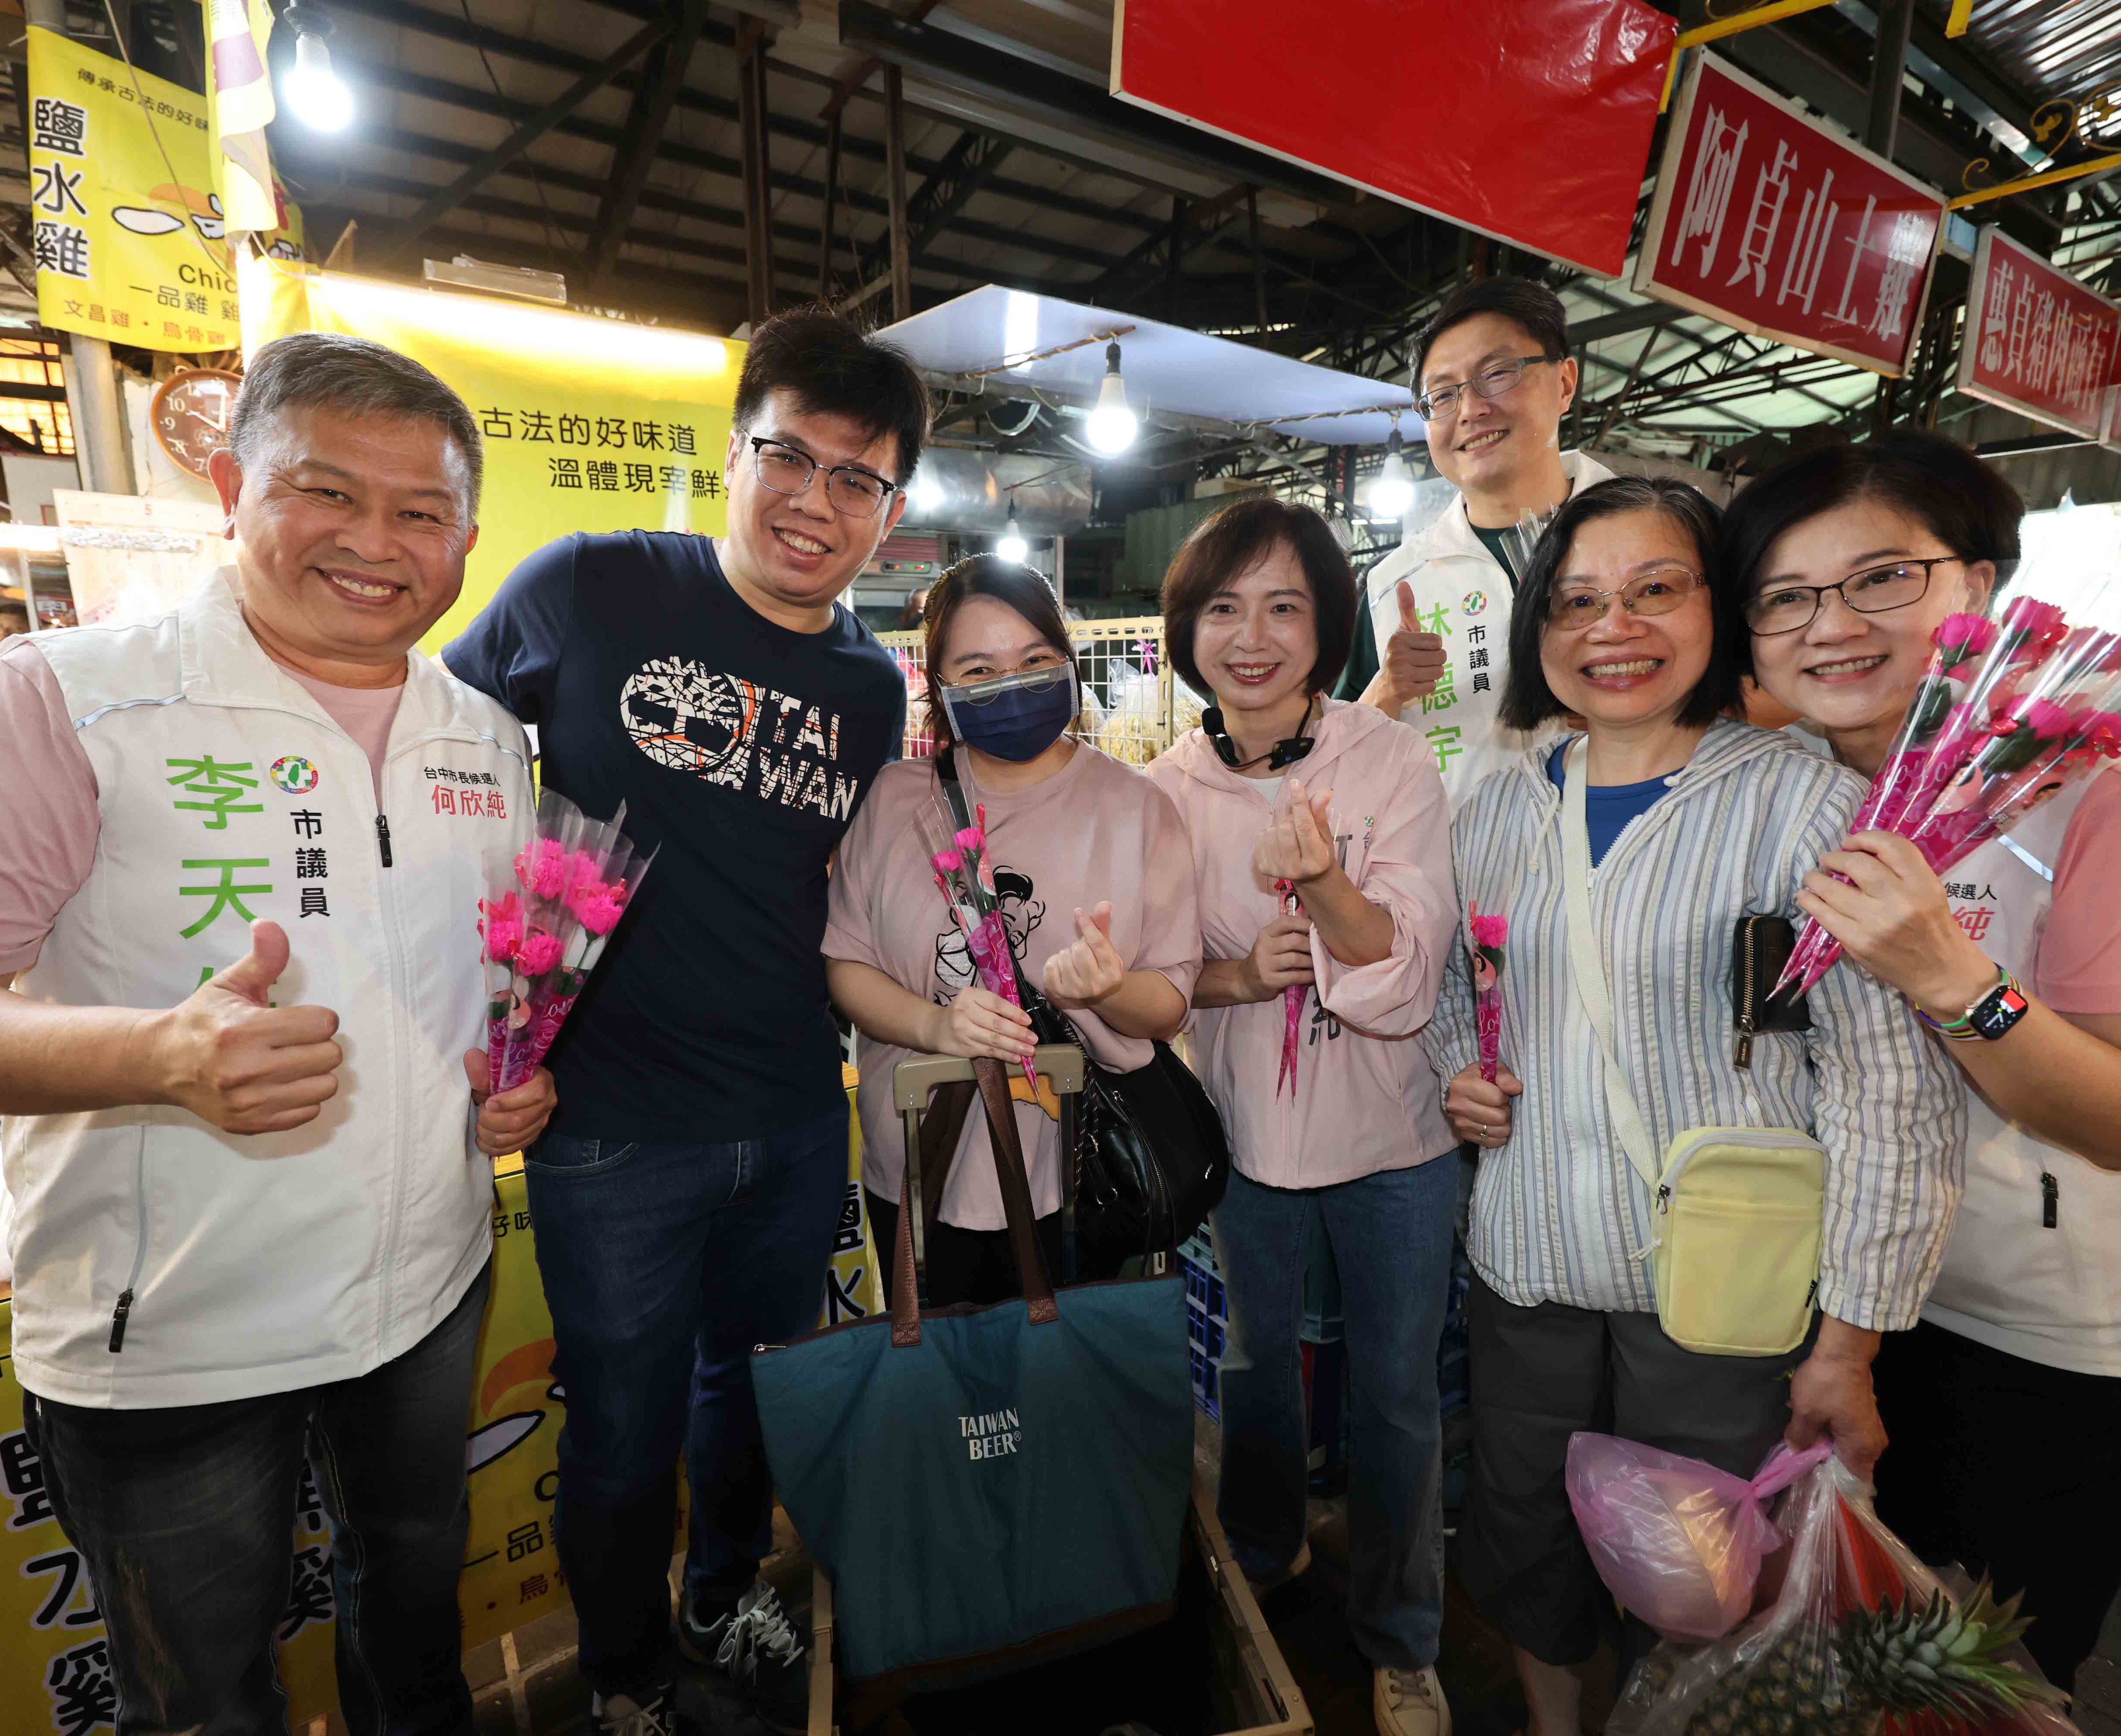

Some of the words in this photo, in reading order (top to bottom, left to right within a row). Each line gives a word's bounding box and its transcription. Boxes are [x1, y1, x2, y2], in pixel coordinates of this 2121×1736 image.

[33, 99, 87, 278] 鹽水雞
[166, 396, 186, 412] 10
[164, 416, 175, 431] 9
[478, 407, 697, 456] 古法的好味道
[548, 457, 729, 500] 溫體現宰鮮
[1467, 625, 1491, 694] 市議員
[424, 766, 501, 787] 台中市長候選人
[431, 784, 507, 815] 何欣純
[166, 755, 276, 1008] 李天
[289, 809, 331, 919] 市議員
[1945, 881, 1997, 900] 候選人
[958, 1407, 1019, 1437] TAIWAN
